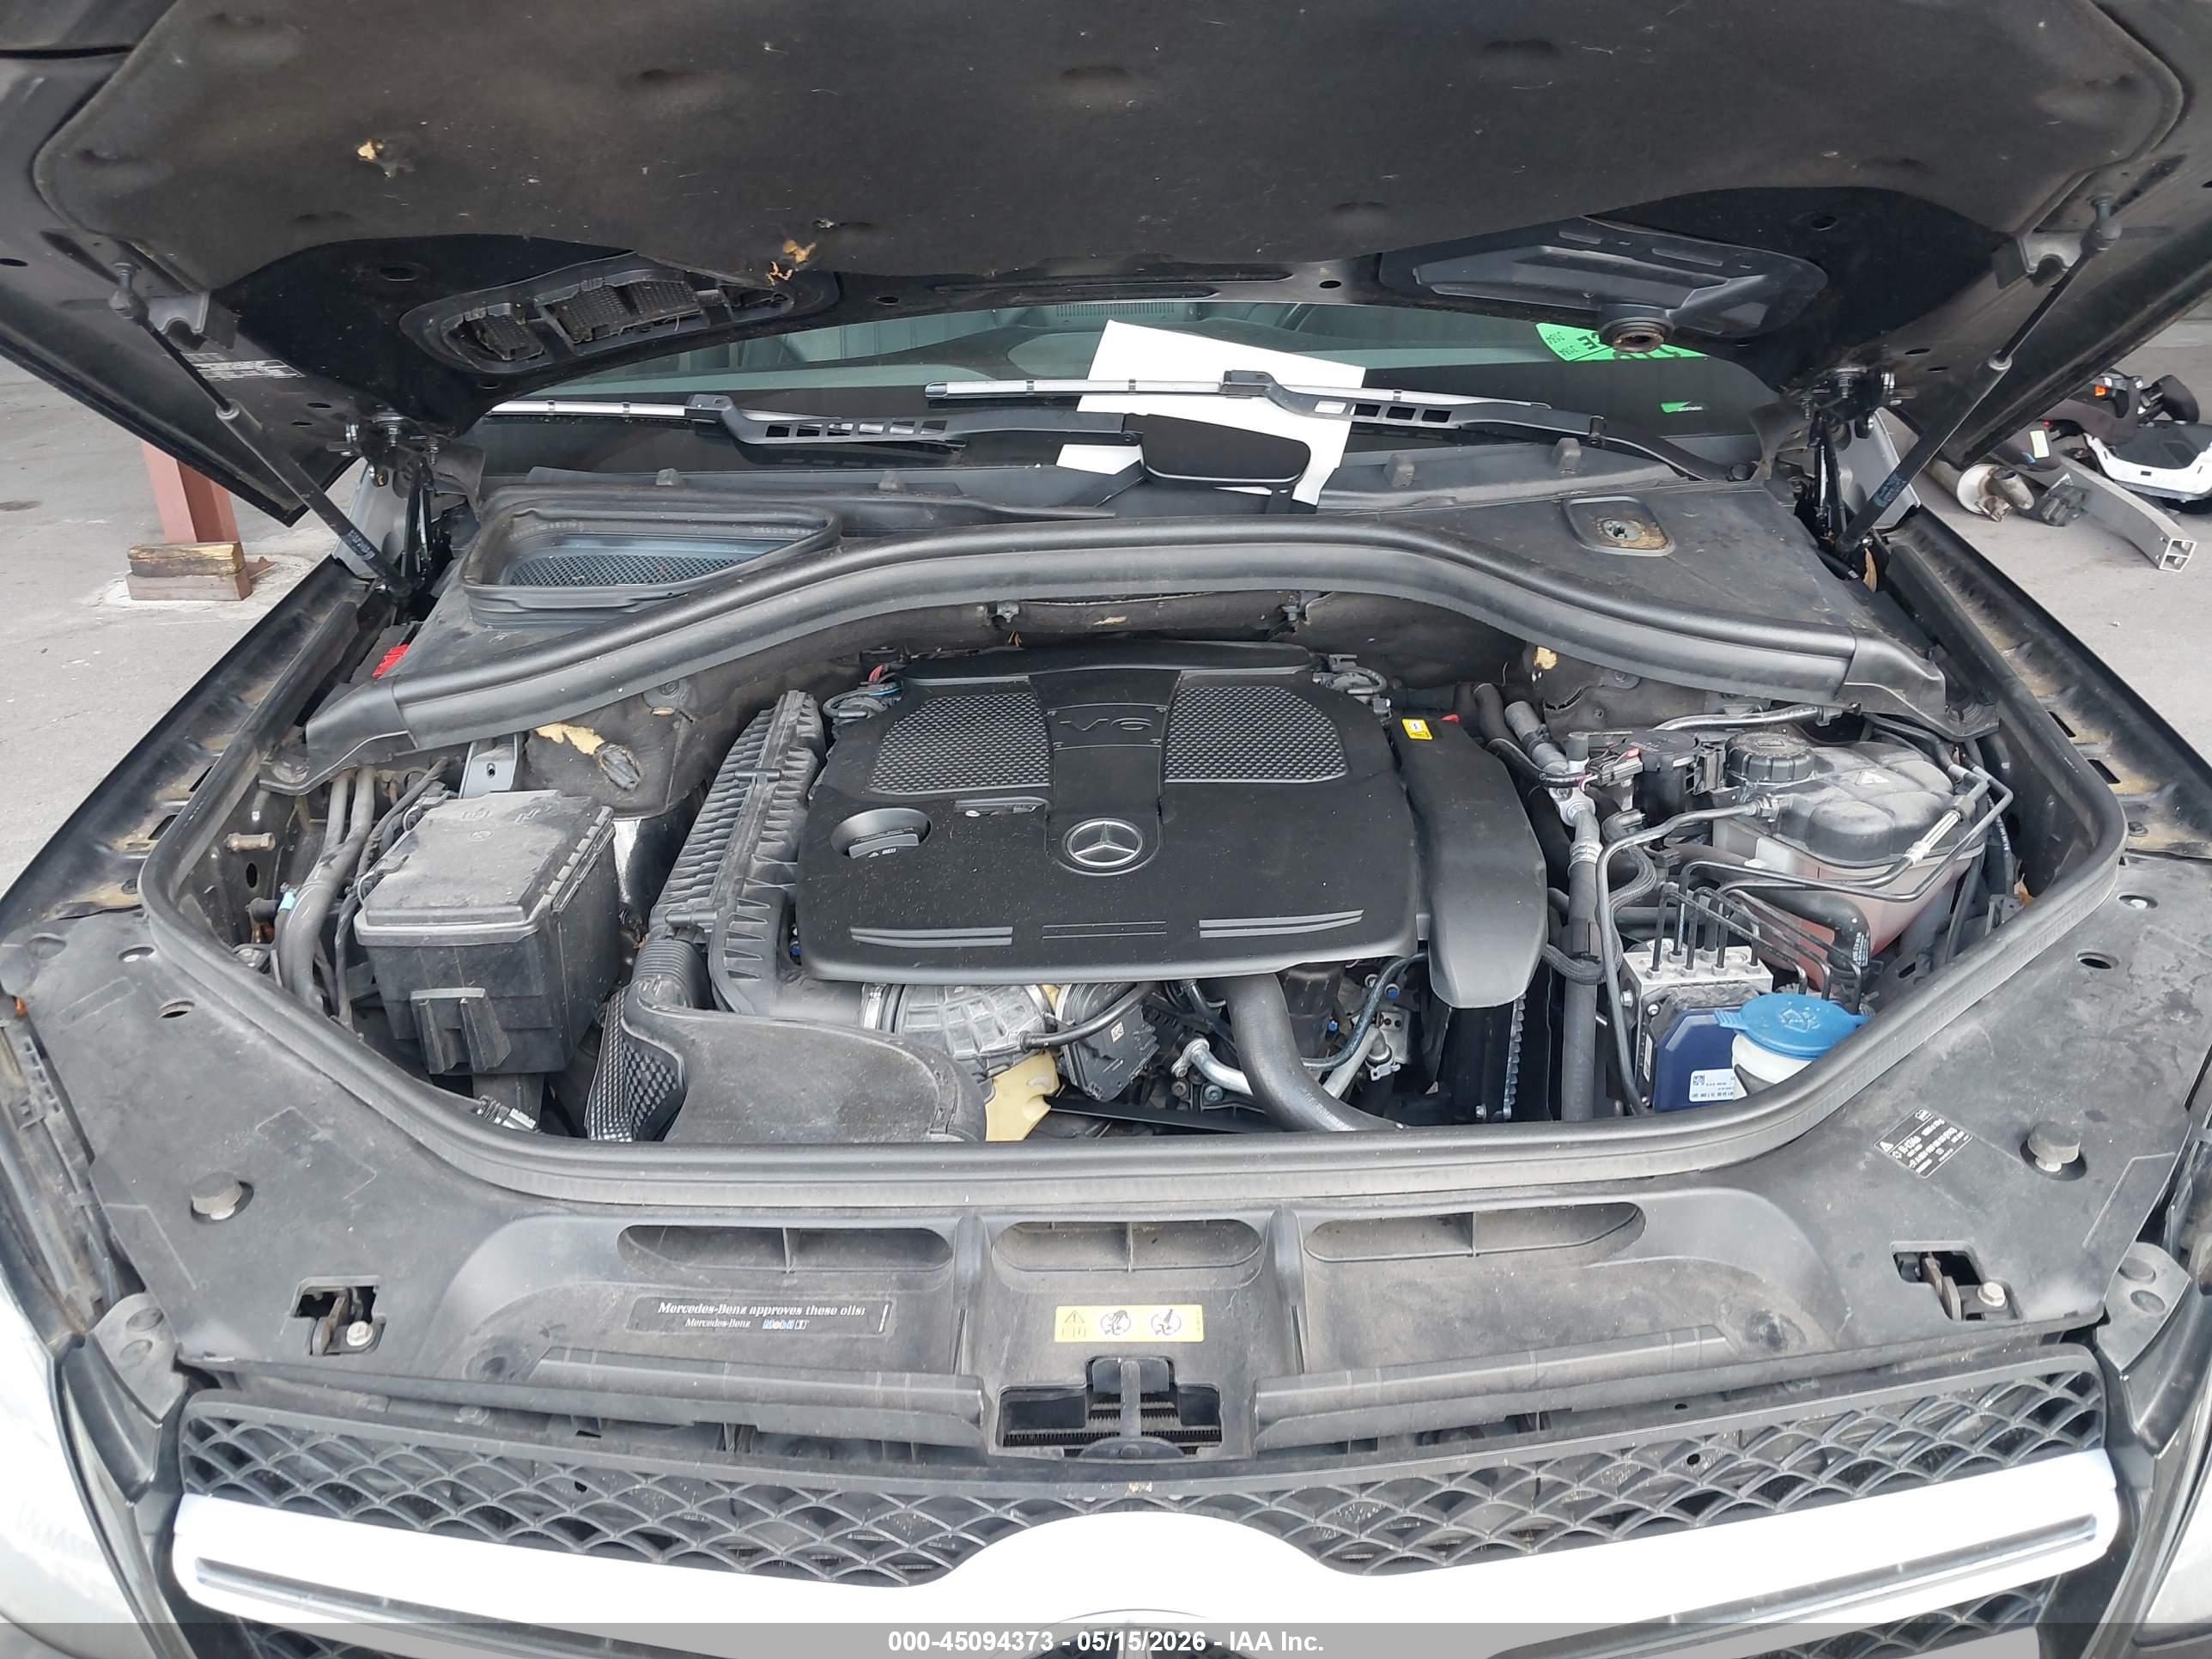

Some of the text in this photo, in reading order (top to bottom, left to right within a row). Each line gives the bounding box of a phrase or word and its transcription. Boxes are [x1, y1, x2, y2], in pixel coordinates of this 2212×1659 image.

[1058, 716, 1154, 734] V6
[658, 1302, 746, 1316] Mercedes-Benz
[749, 1304, 803, 1317] approves
[805, 1304, 838, 1316] these
[684, 1317, 750, 1328] Mercedes-Benz
